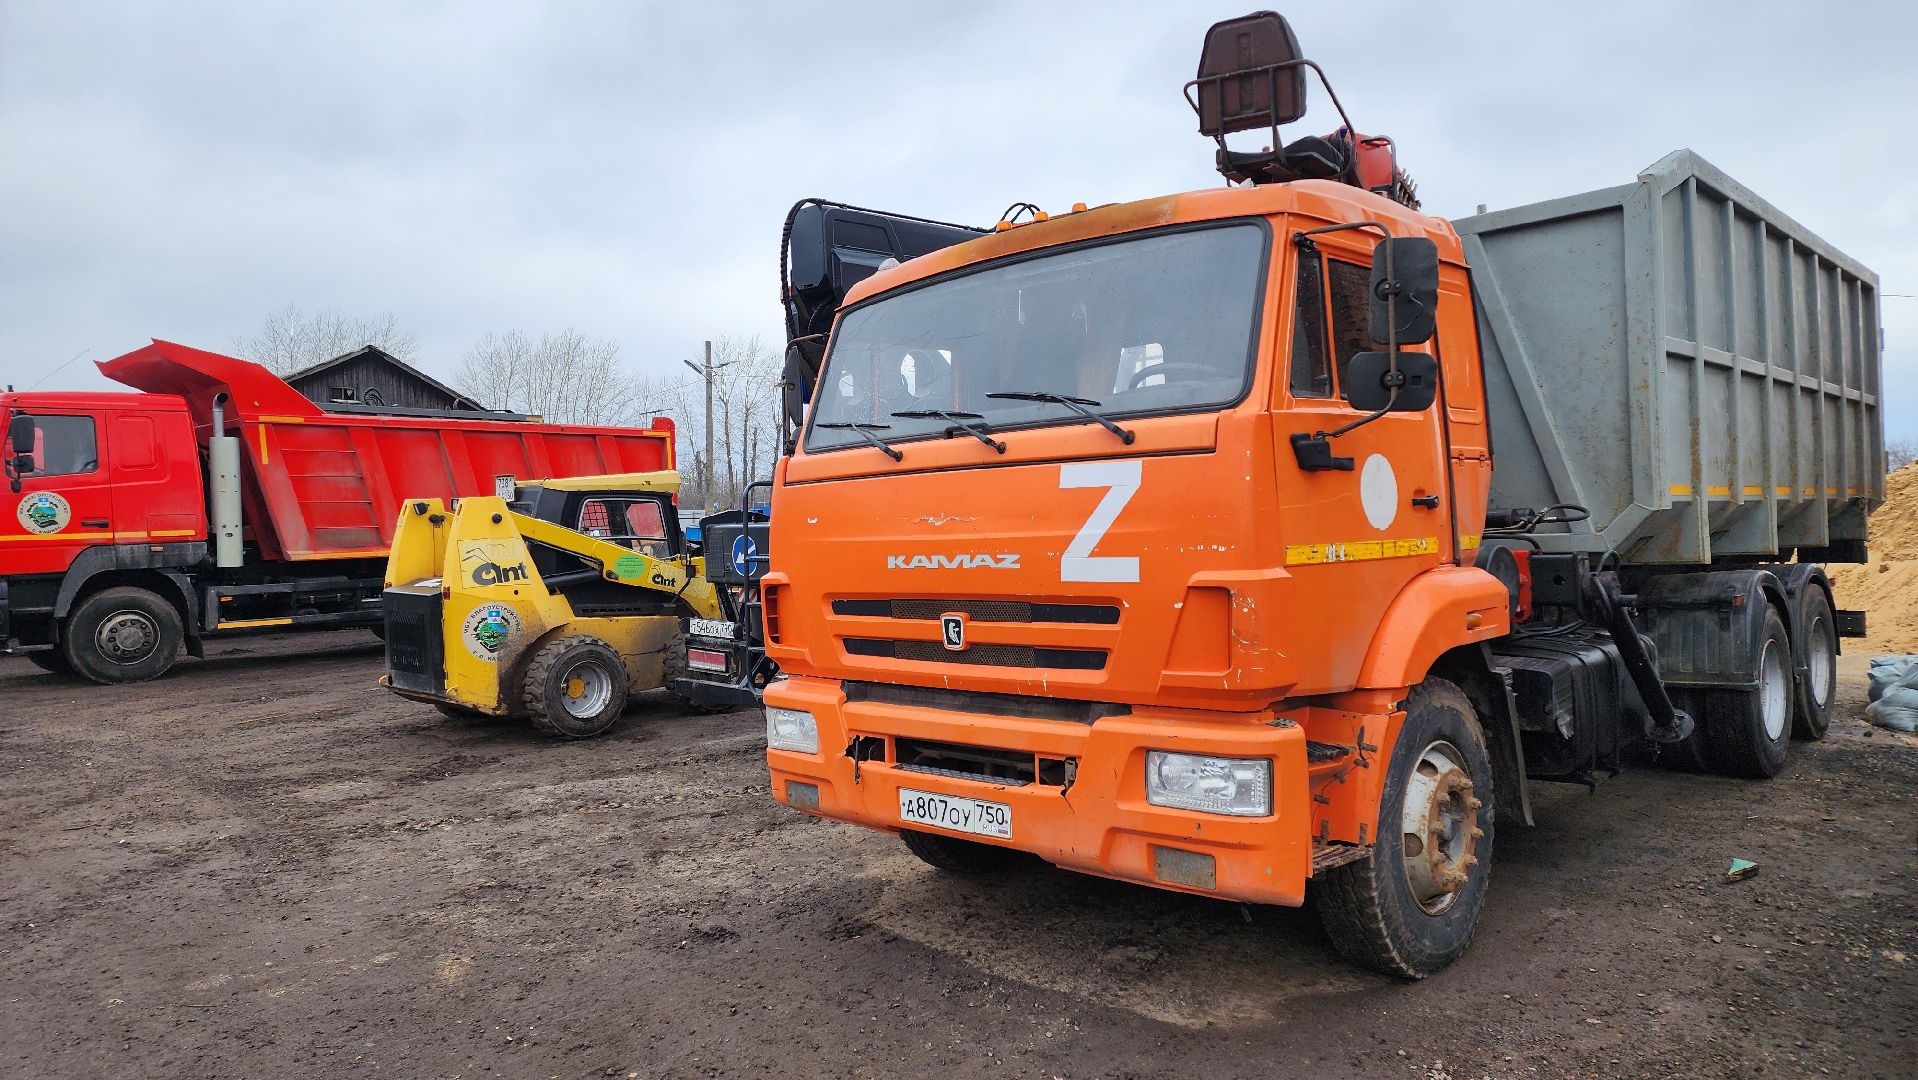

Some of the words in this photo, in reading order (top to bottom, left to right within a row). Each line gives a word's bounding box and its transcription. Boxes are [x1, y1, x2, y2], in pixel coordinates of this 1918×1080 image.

[1059, 460, 1143, 582] Z
[887, 554, 1020, 569] KAMAZ
[906, 796, 971, 827] А807ОУ
[976, 803, 1005, 825] 750
[983, 824, 997, 834] RUS
